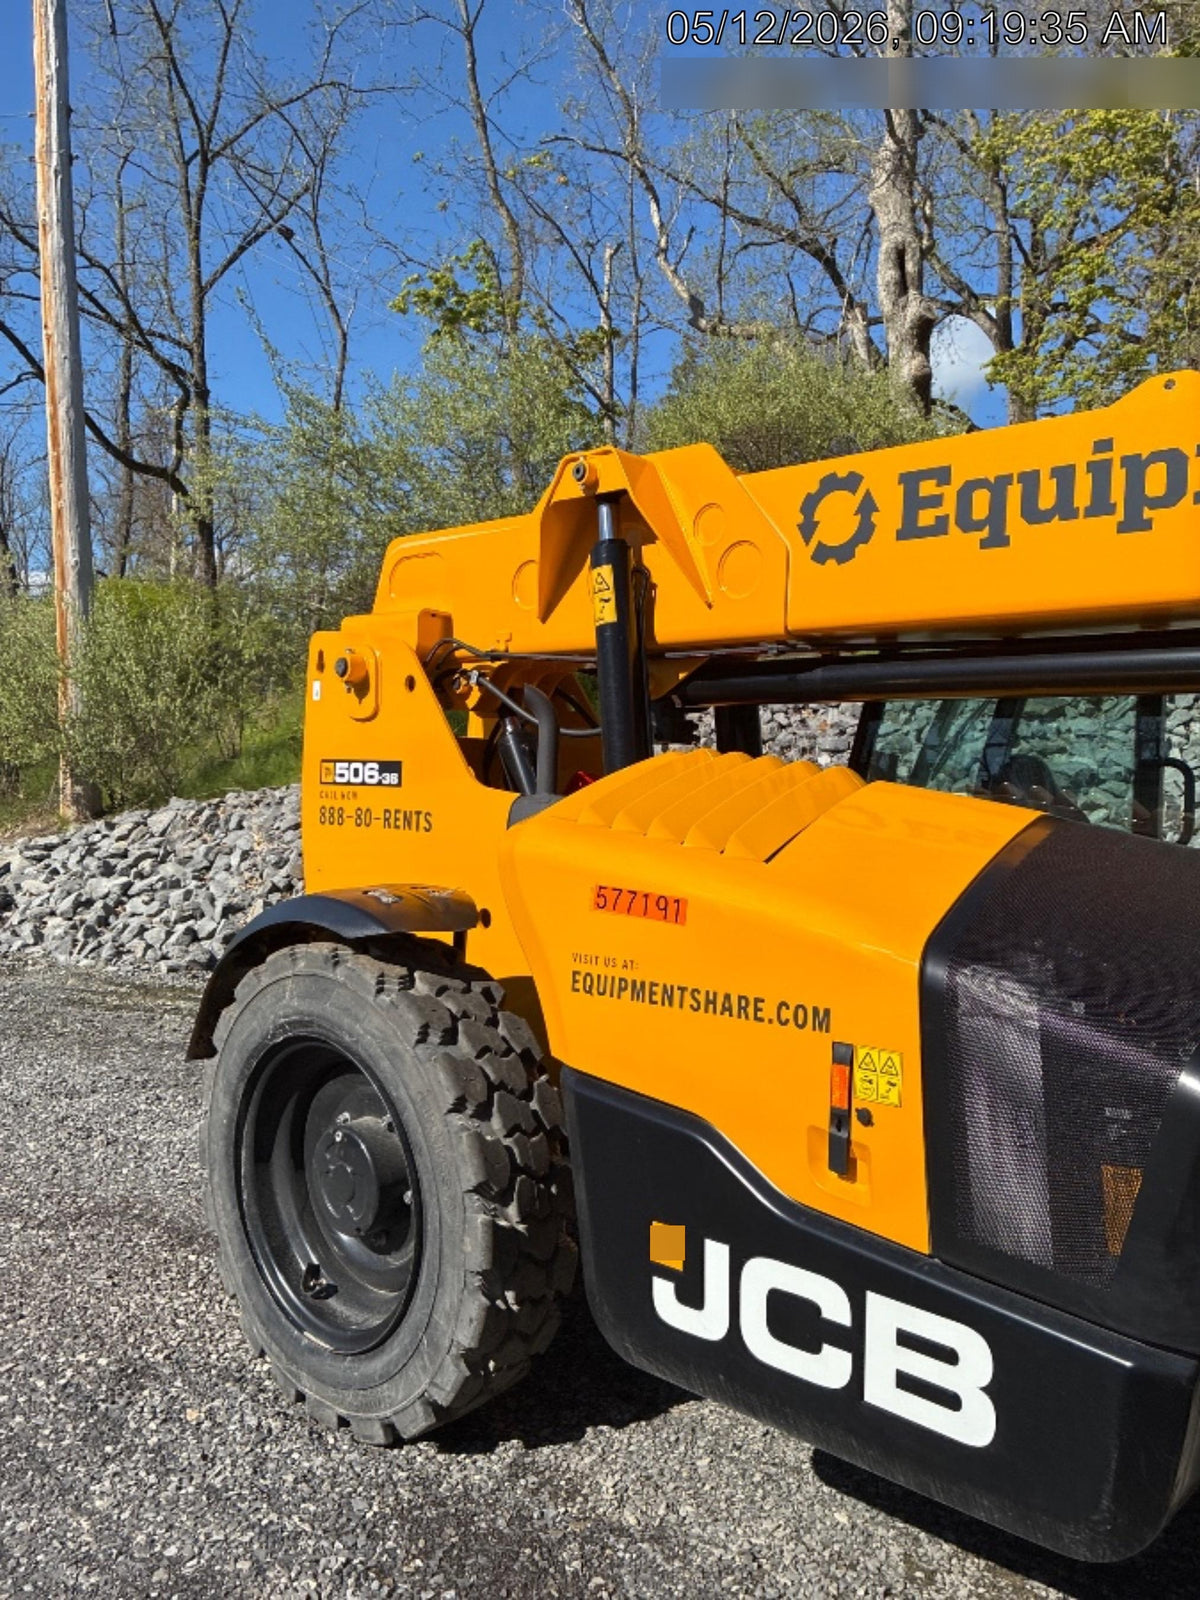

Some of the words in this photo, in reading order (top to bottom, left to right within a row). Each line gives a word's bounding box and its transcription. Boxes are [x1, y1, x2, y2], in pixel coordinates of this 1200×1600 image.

[896, 437, 1200, 549] Equip
[319, 805, 433, 832] 888-80-RENTS
[596, 885, 682, 923] 577191
[571, 952, 599, 966] VISIT
[604, 955, 617, 968] US
[622, 959, 639, 971] AT:
[571, 970, 832, 1035] EQUIPMENTSHARE.COM
[652, 1239, 996, 1448] JCB
